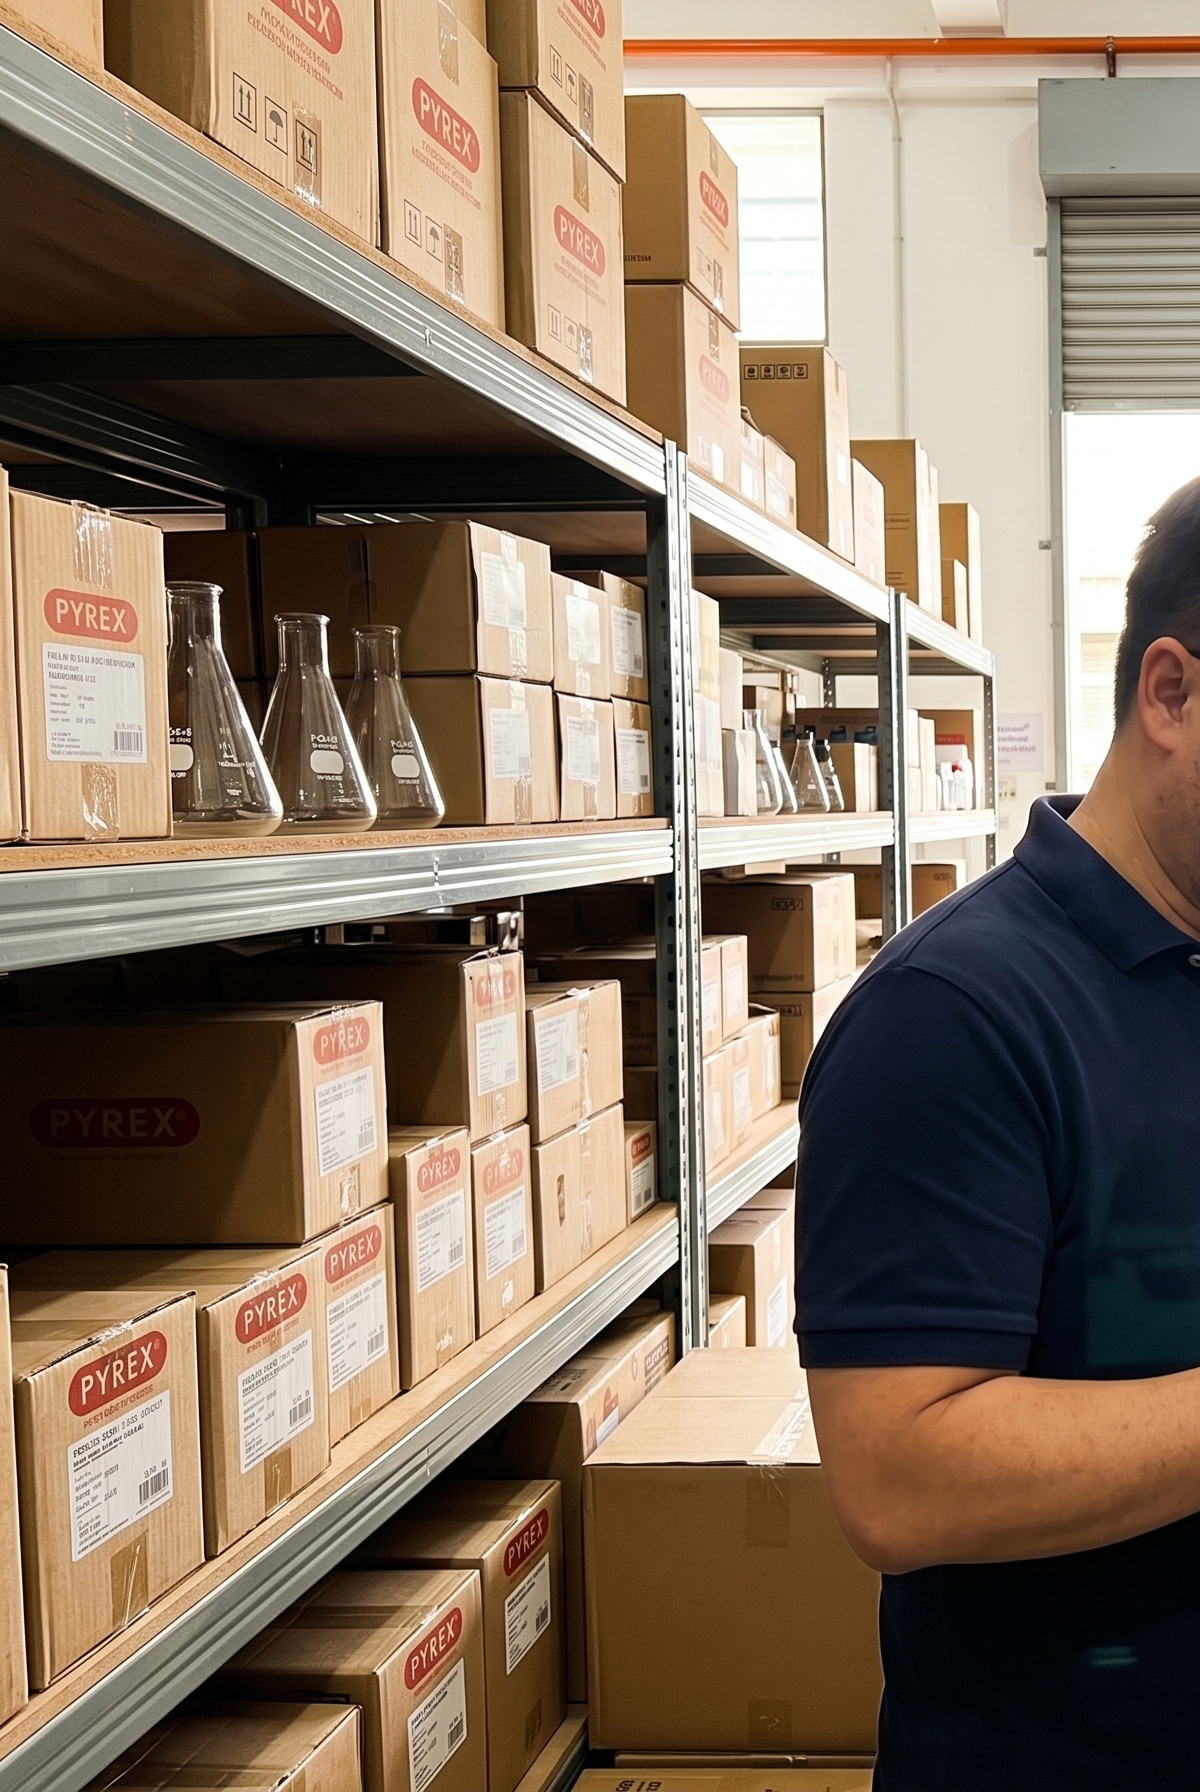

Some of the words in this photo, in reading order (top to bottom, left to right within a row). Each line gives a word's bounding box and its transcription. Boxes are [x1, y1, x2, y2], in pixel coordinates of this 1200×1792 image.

[420, 88, 472, 162] PYREX
[560, 213, 600, 268] PYREX
[56, 597, 127, 634] PYREX
[321, 1023, 364, 1057] PYREX
[50, 1107, 177, 1138] PYREX
[421, 1154, 456, 1187] PYREX
[331, 1231, 375, 1276] PYREX
[244, 1282, 298, 1335] PYREX
[81, 1341, 154, 1406] PYREX
[508, 1516, 544, 1570] PYREX
[410, 1619, 457, 1681] PYREX
